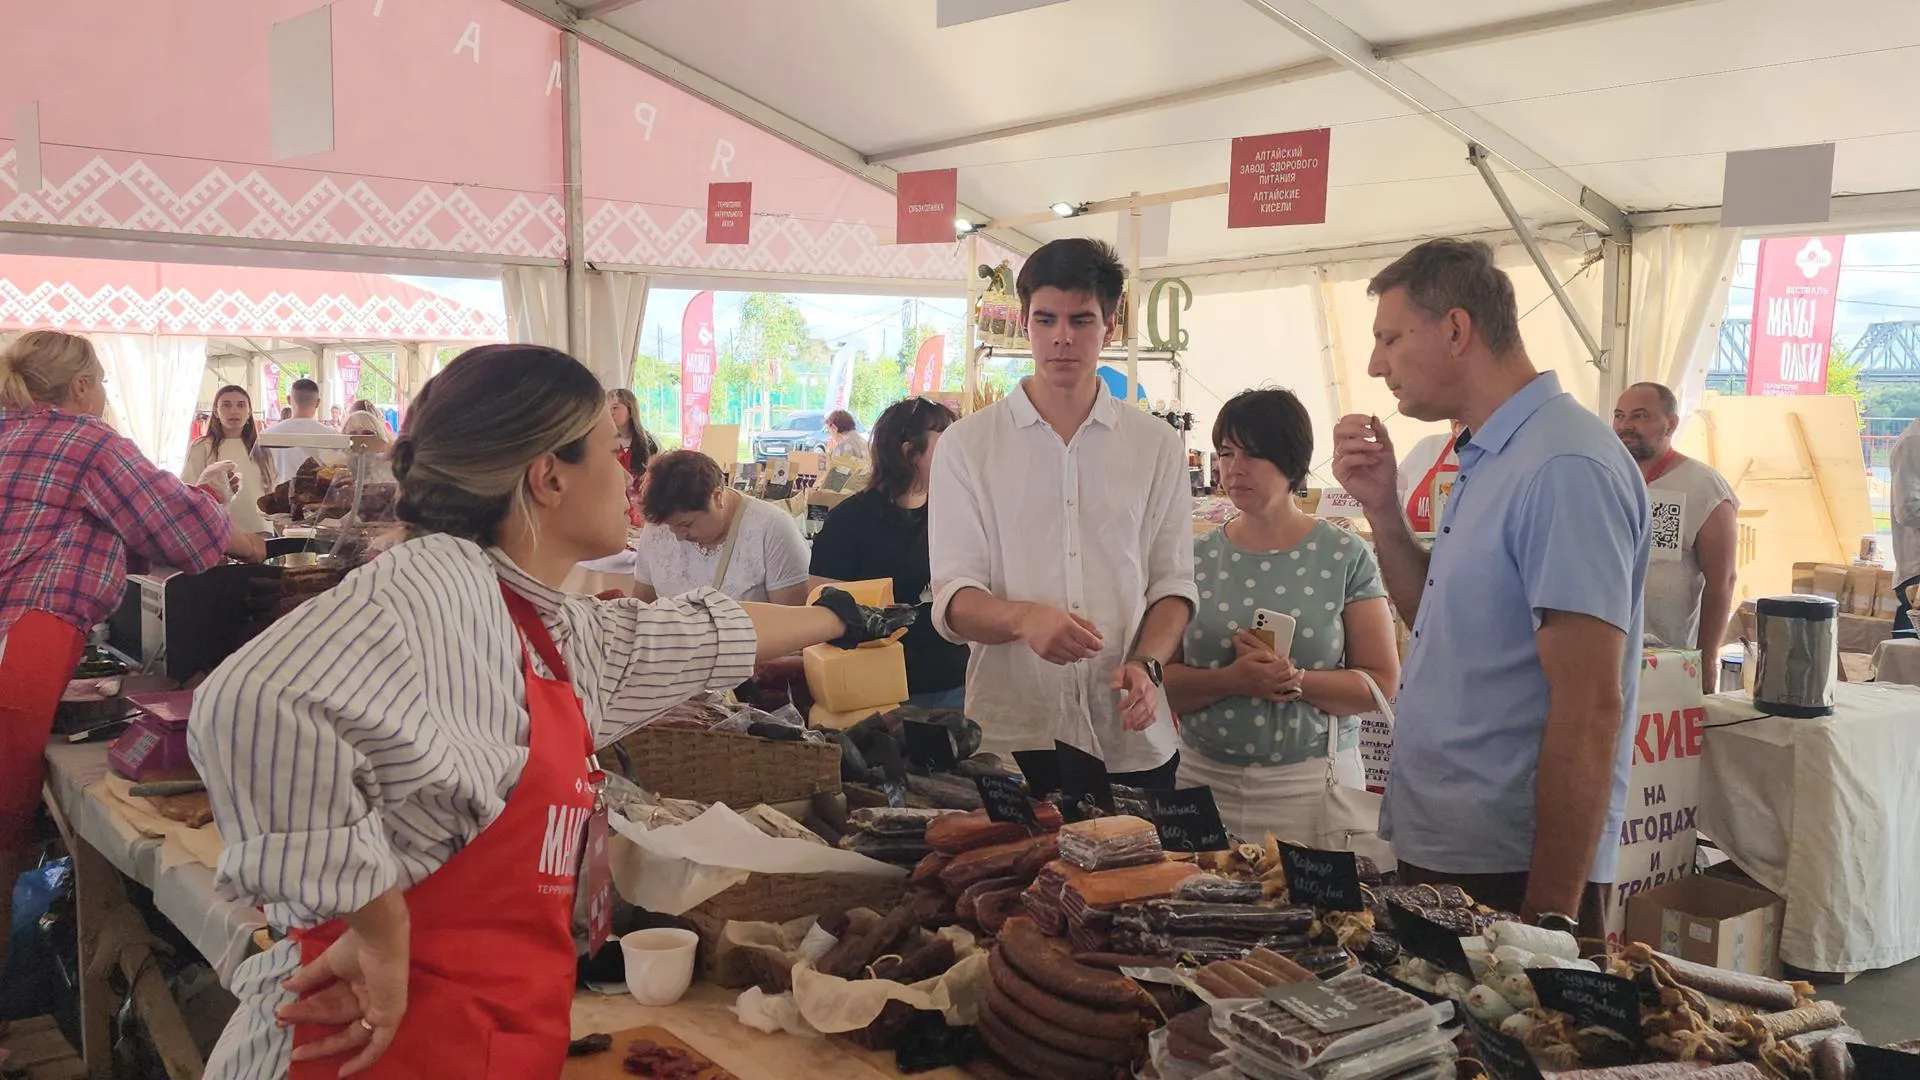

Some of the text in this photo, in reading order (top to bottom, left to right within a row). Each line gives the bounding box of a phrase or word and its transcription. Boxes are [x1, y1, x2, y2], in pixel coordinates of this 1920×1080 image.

[1255, 145, 1303, 161] АЛТАЙСКИЙ
[1240, 158, 1319, 175] ЗАВОД ЗДОРОВОГО
[1259, 172, 1296, 185] ПИТАНИЯ
[1253, 188, 1301, 202] АЛТАЙСКИЕ
[1260, 202, 1292, 213] КИСЕЛИ
[1643, 783, 1666, 807] НА
[1650, 850, 1661, 873] И
